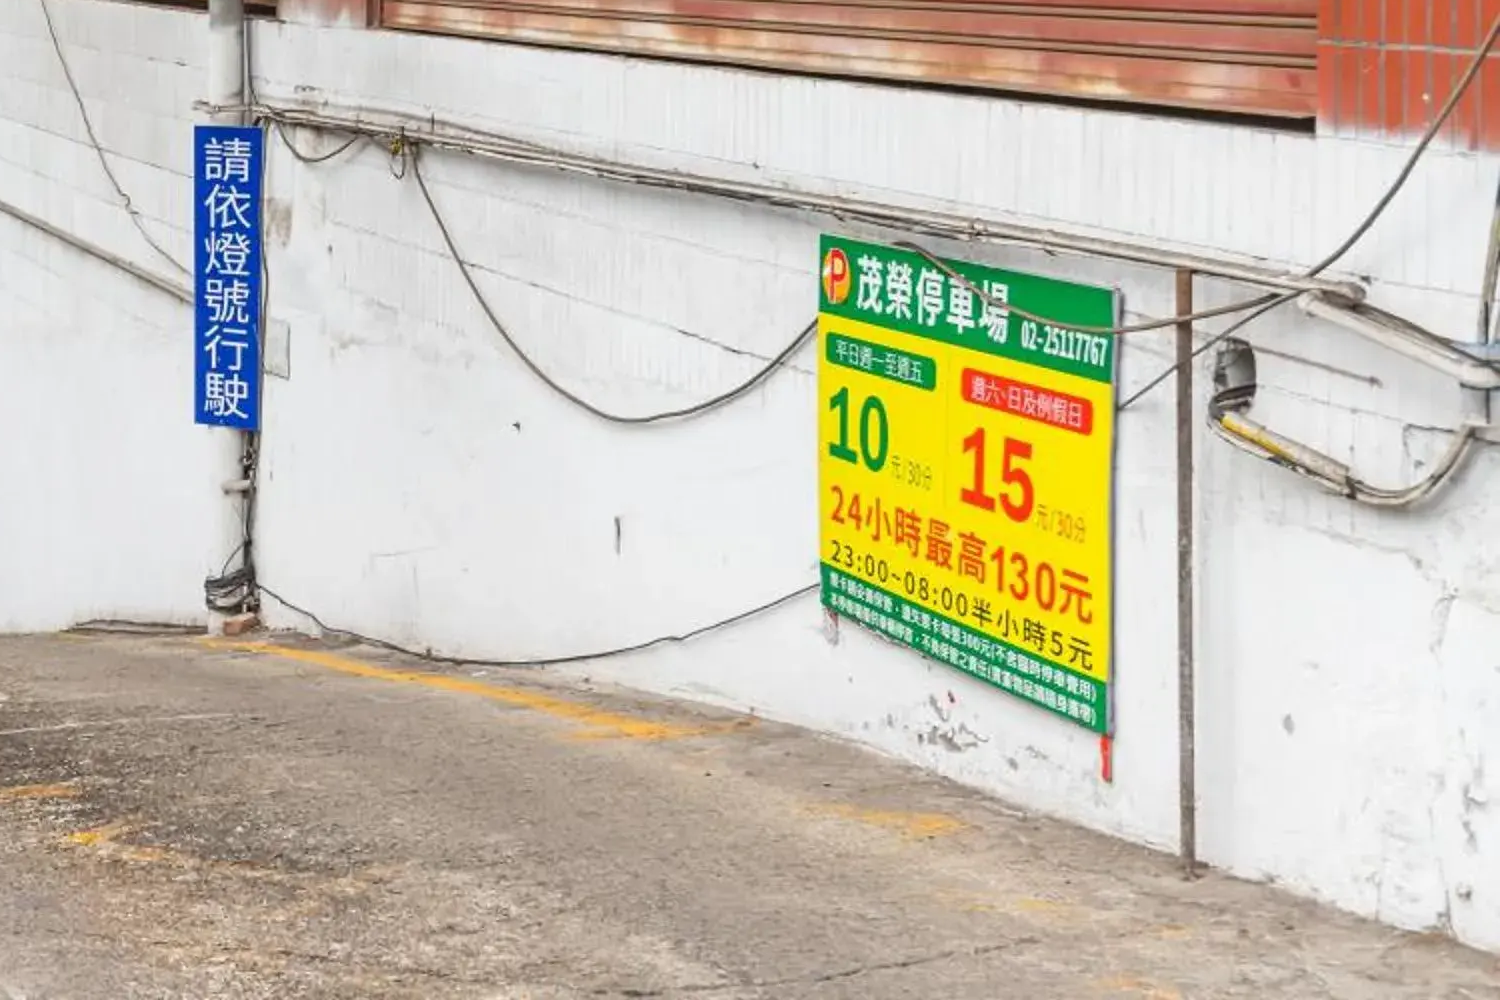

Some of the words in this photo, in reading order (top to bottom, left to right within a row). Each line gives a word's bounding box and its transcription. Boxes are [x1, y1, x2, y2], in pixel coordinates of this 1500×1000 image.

[203, 138, 252, 419] 請依燈號行駛
[856, 253, 1010, 345] 茂榮停車場
[1021, 320, 1108, 368] 02-25117767
[828, 386, 889, 473] 10
[960, 426, 1035, 524] 15
[830, 485, 1094, 626] 24小時最高130元
